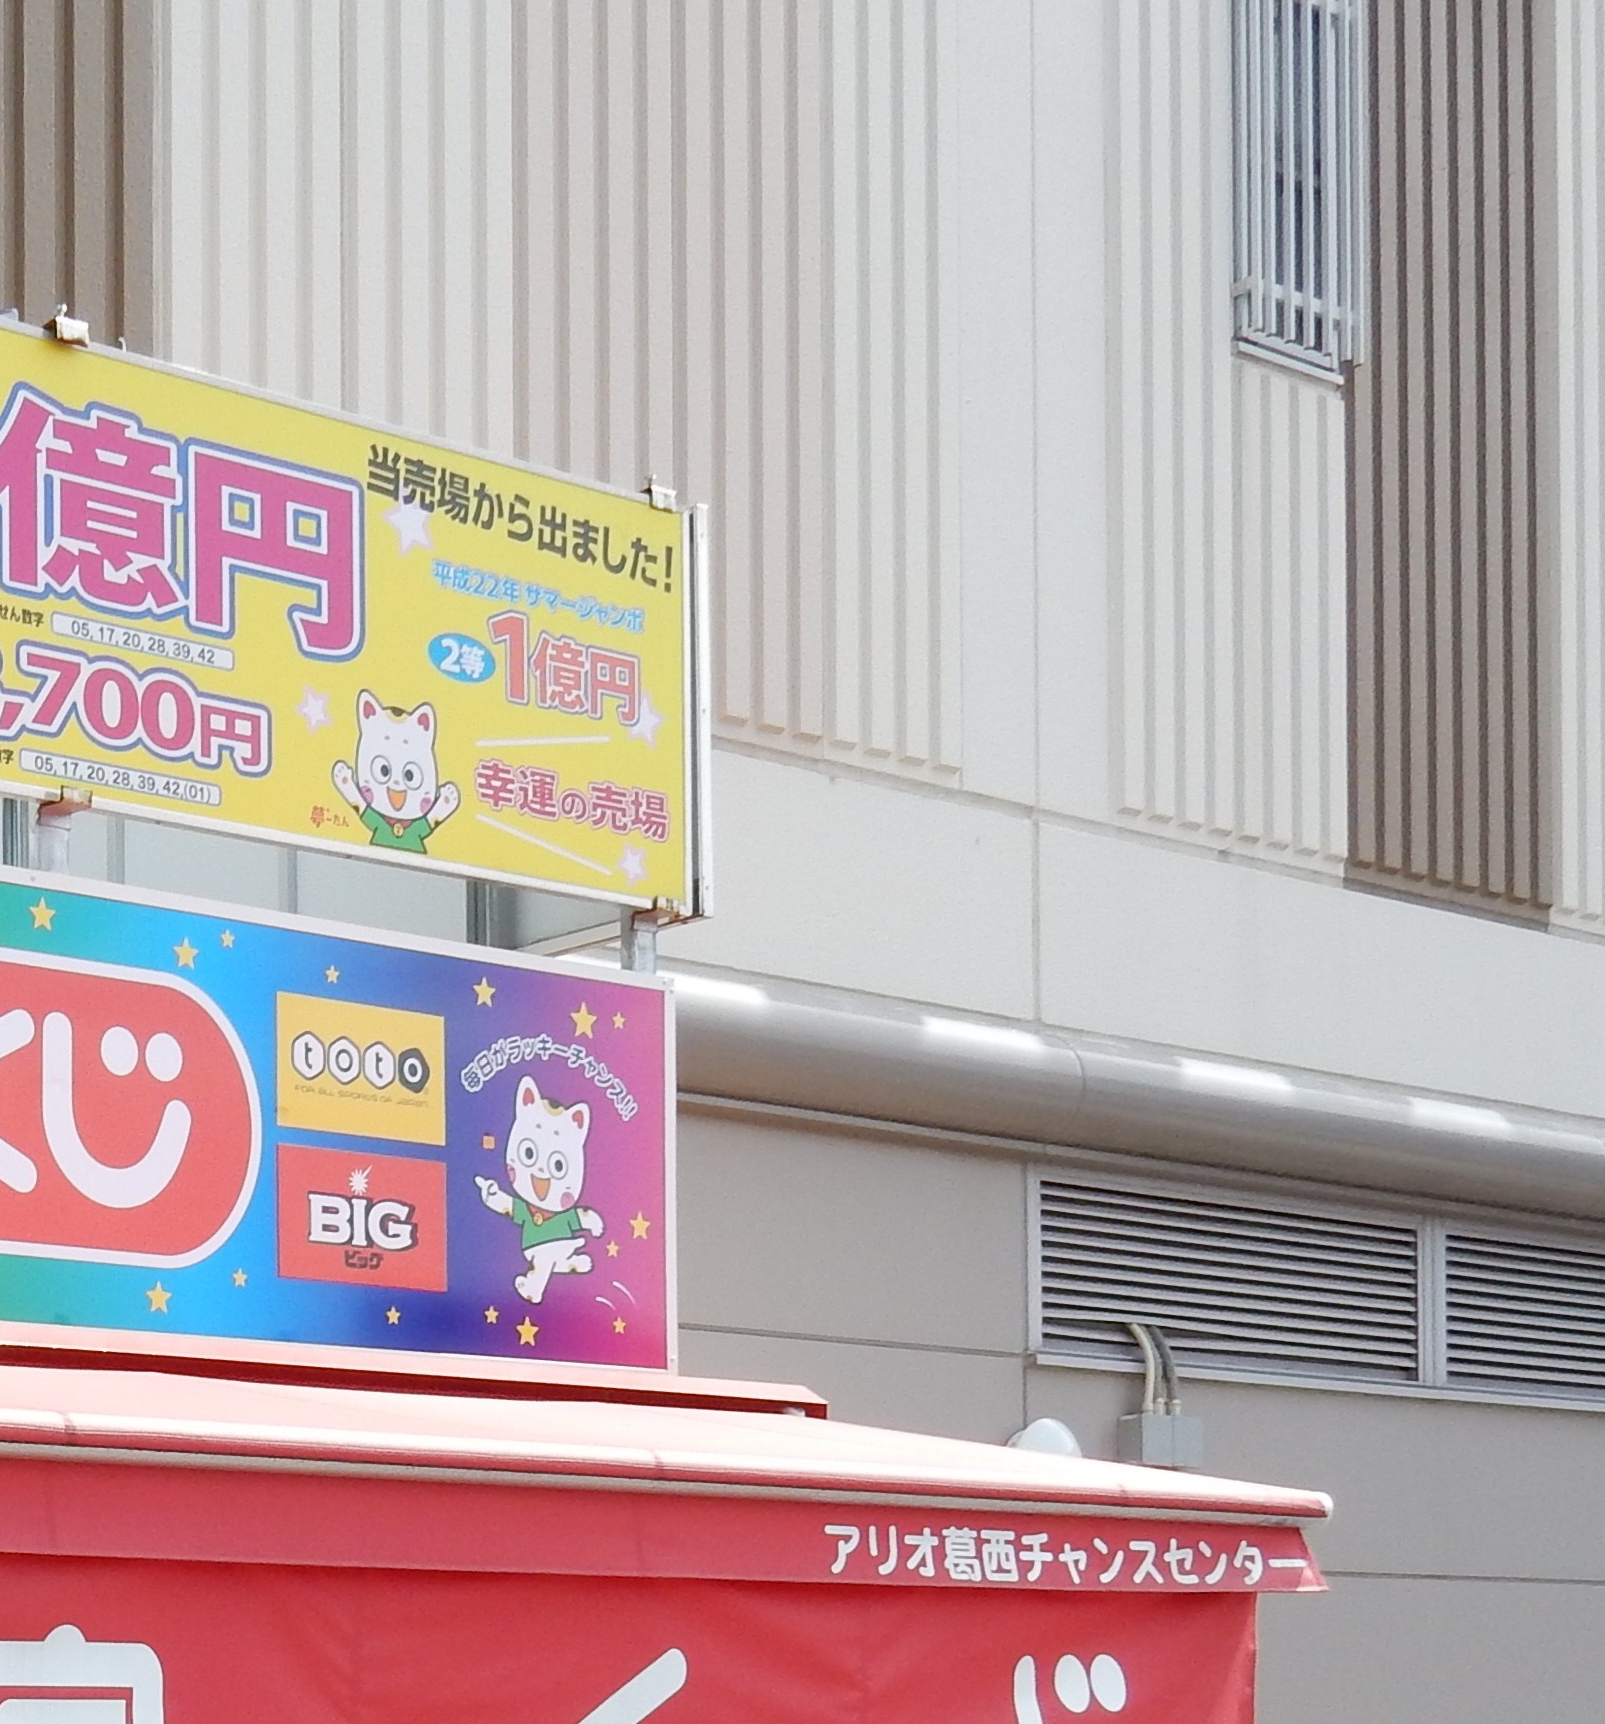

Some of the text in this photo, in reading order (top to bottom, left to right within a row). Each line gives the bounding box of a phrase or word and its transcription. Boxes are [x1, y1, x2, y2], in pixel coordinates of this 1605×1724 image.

[366, 443, 674, 594] 当売場から出ました!
[439, 610, 641, 727] 2等 1億円
[473, 756, 670, 842] 幸運の売場
[291, 1030, 430, 1094] toto
[461, 1034, 639, 1121] 毎日がラッキーチャンス!!
[307, 1191, 418, 1252] BIG
[344, 1249, 385, 1271] ビッグ
[823, 1524, 1309, 1587] アリオ葛西チャンスセンター
